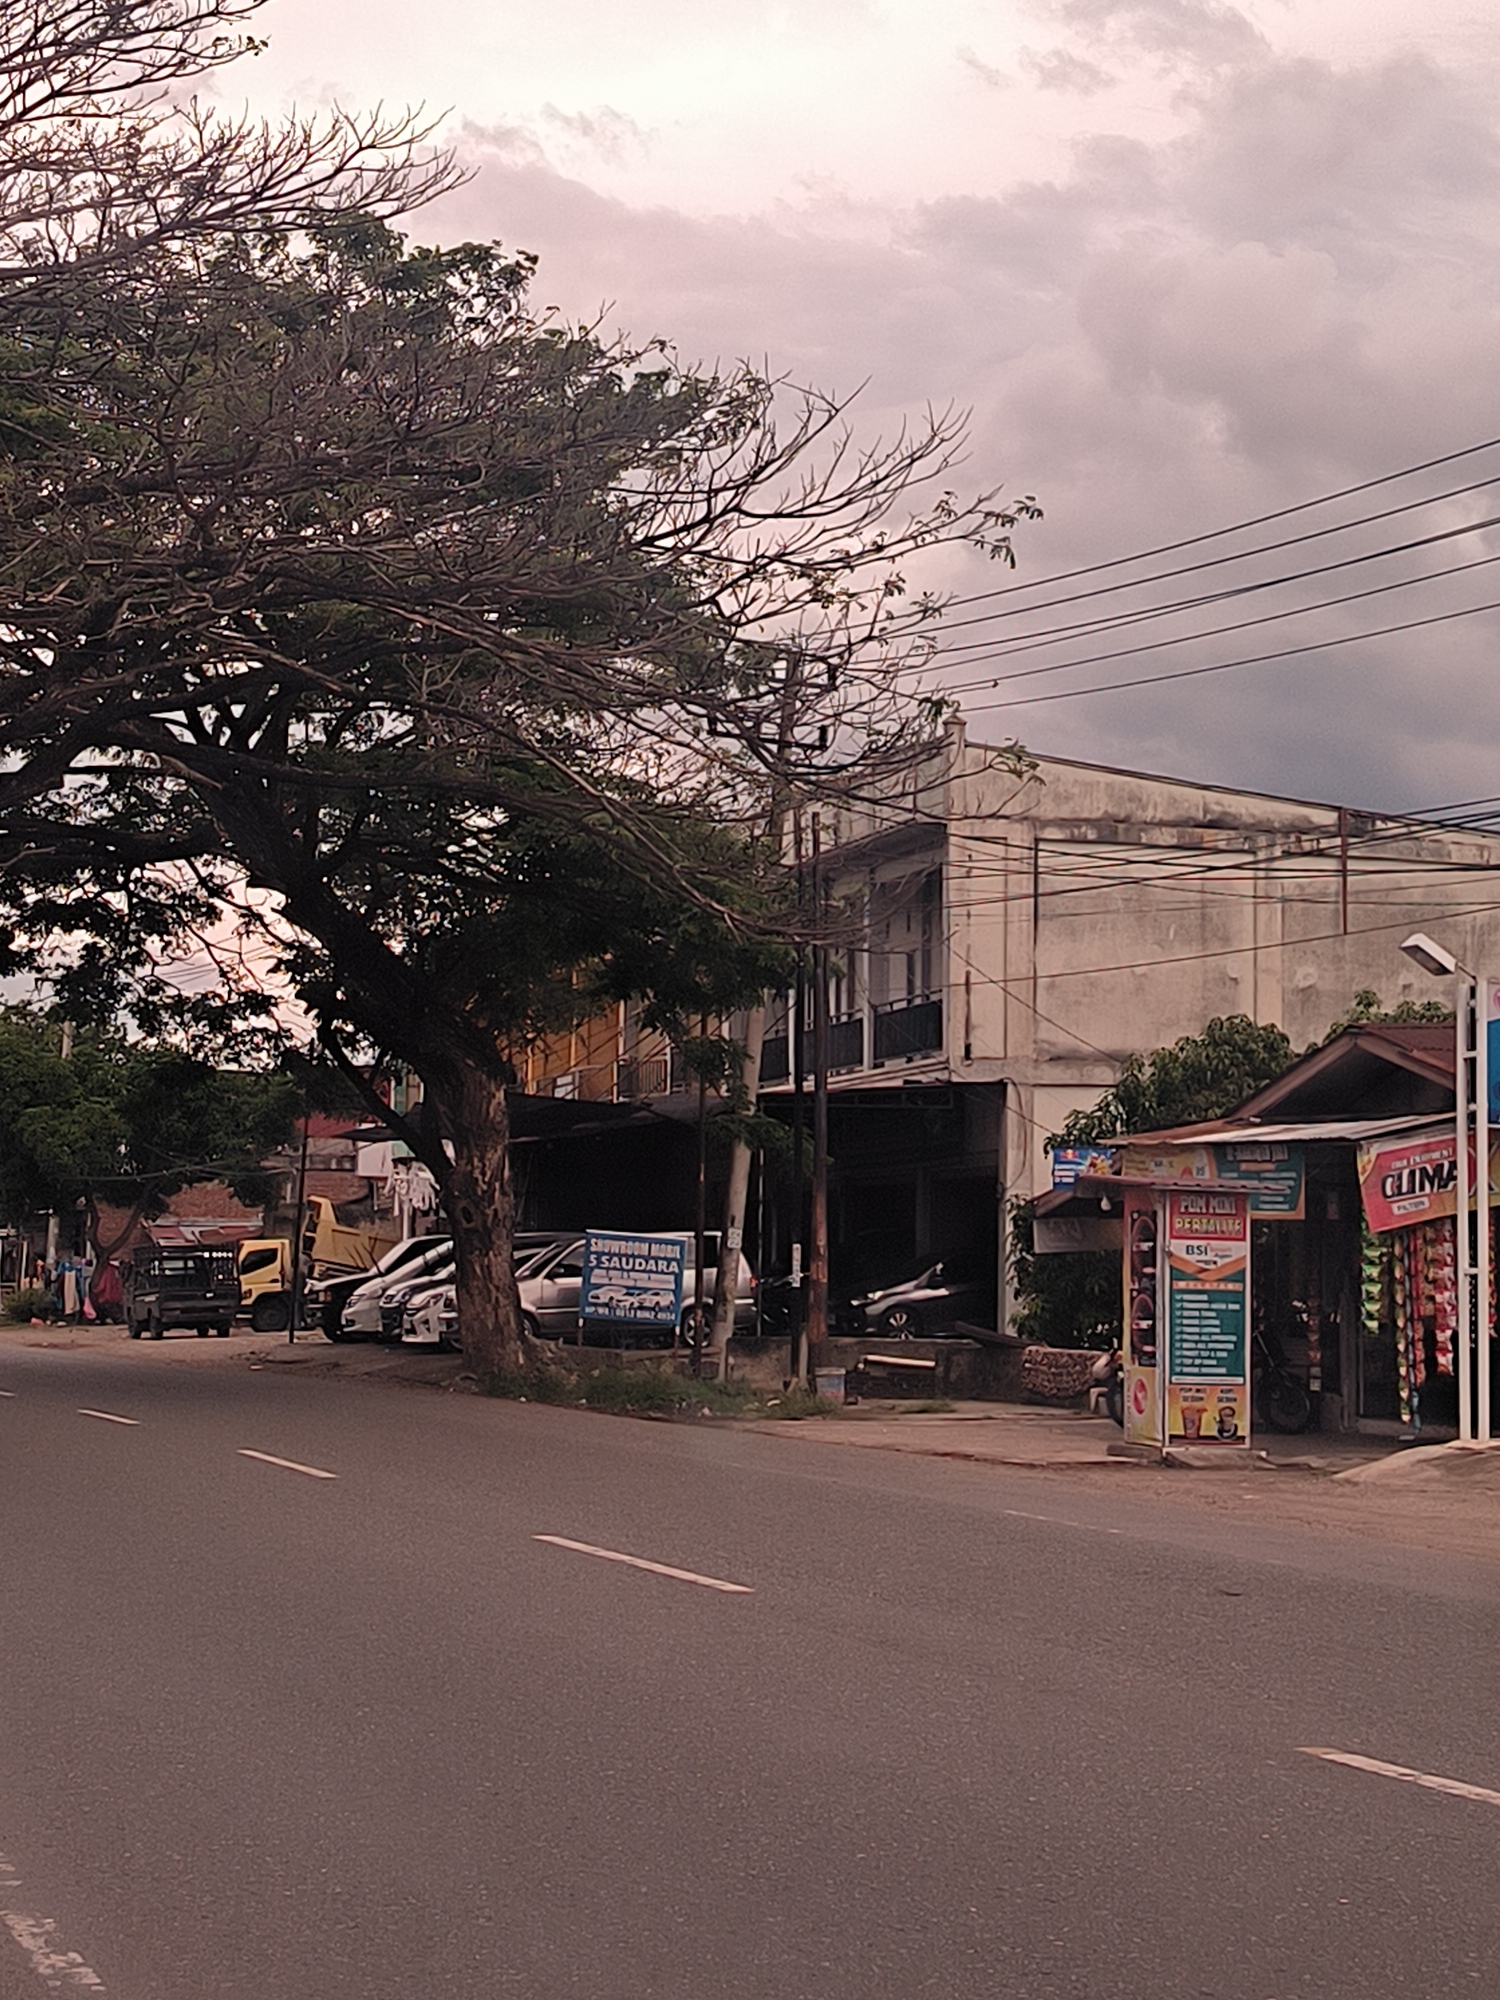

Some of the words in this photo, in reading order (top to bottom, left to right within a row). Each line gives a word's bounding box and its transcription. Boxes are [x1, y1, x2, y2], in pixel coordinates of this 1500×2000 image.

[1180, 1195, 1207, 1213] POM
[1209, 1196, 1236, 1214] MINI
[1174, 1216, 1243, 1236] PERTALITE
[590, 1238, 648, 1256] SHOWROOM
[650, 1242, 681, 1259] MOBIL
[1186, 1244, 1208, 1256] BSI
[589, 1255, 598, 1267] 5
[600, 1256, 680, 1273] SAUDARA
